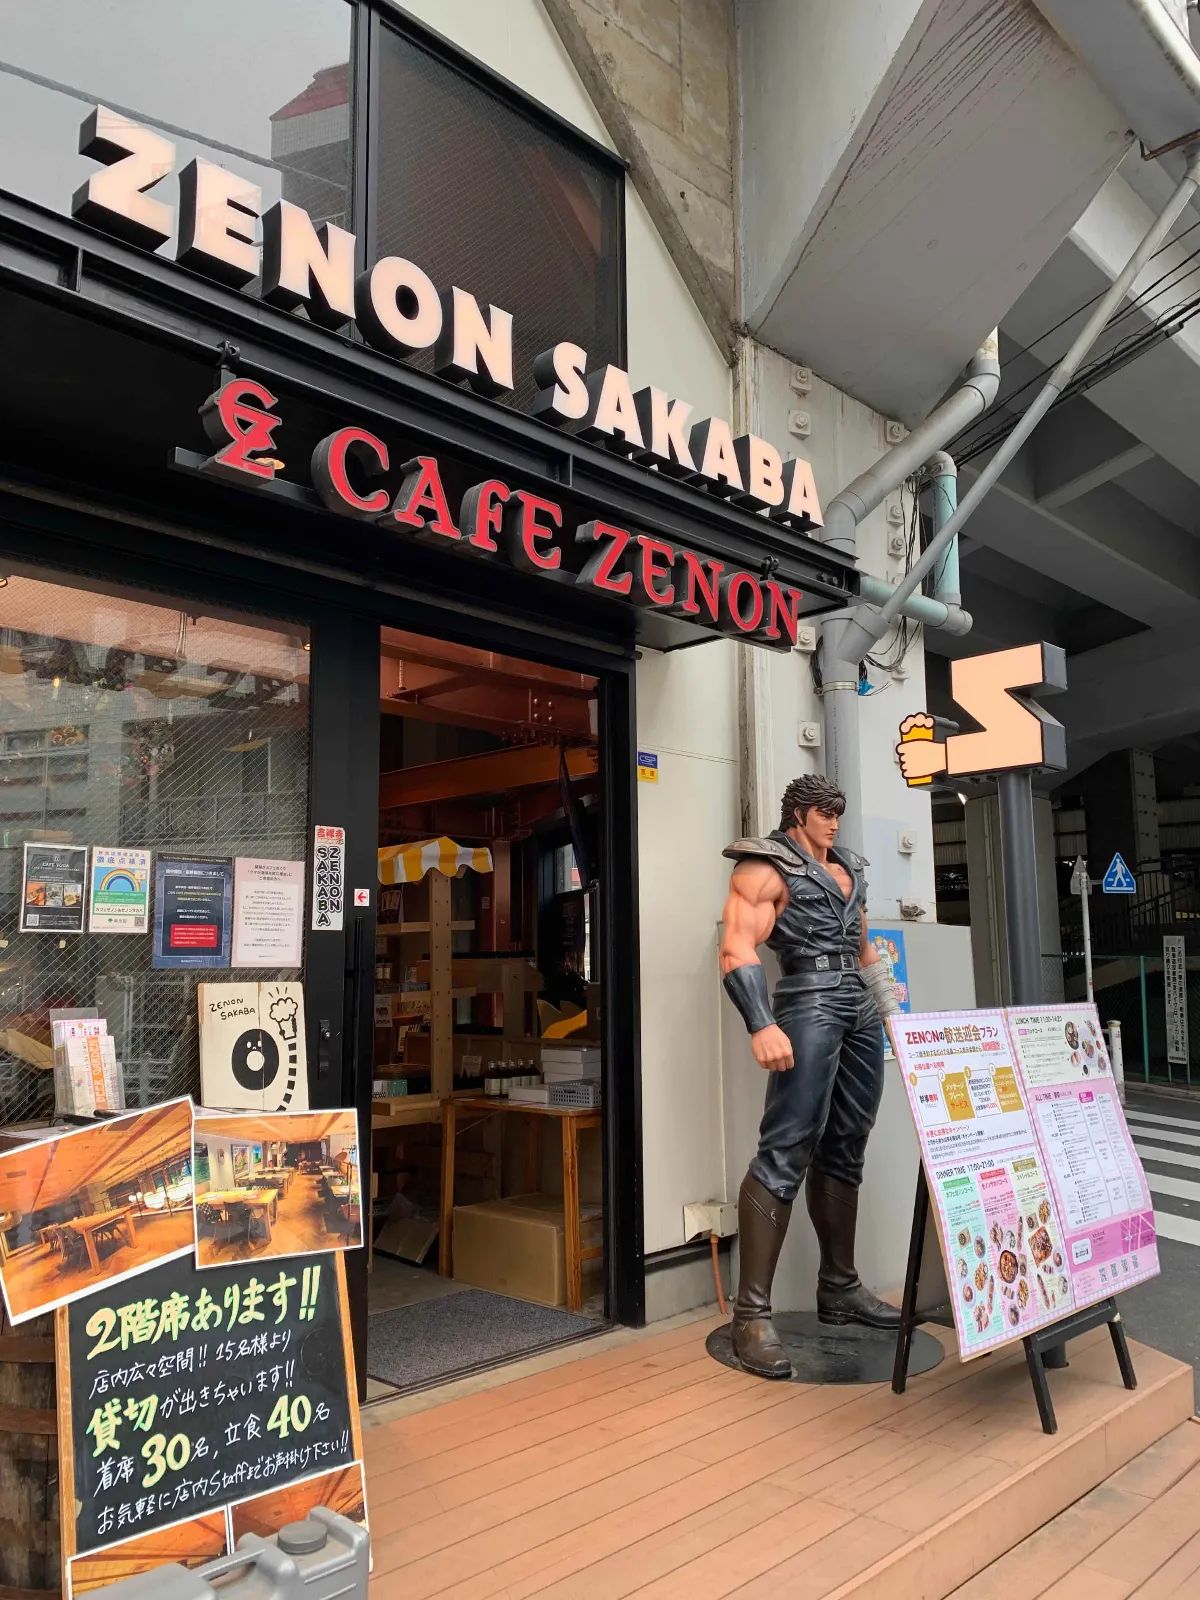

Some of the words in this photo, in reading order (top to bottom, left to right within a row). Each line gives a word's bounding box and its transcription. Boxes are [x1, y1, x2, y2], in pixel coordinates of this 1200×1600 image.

[80, 105, 514, 390] ZENON
[549, 341, 825, 528] SAKABA
[592, 518, 803, 648] ZENON
[317, 848, 328, 924] SAKABA
[329, 848, 340, 912] ZENON
[209, 996, 245, 1013] ZENON
[220, 1006, 257, 1021] SAKABA
